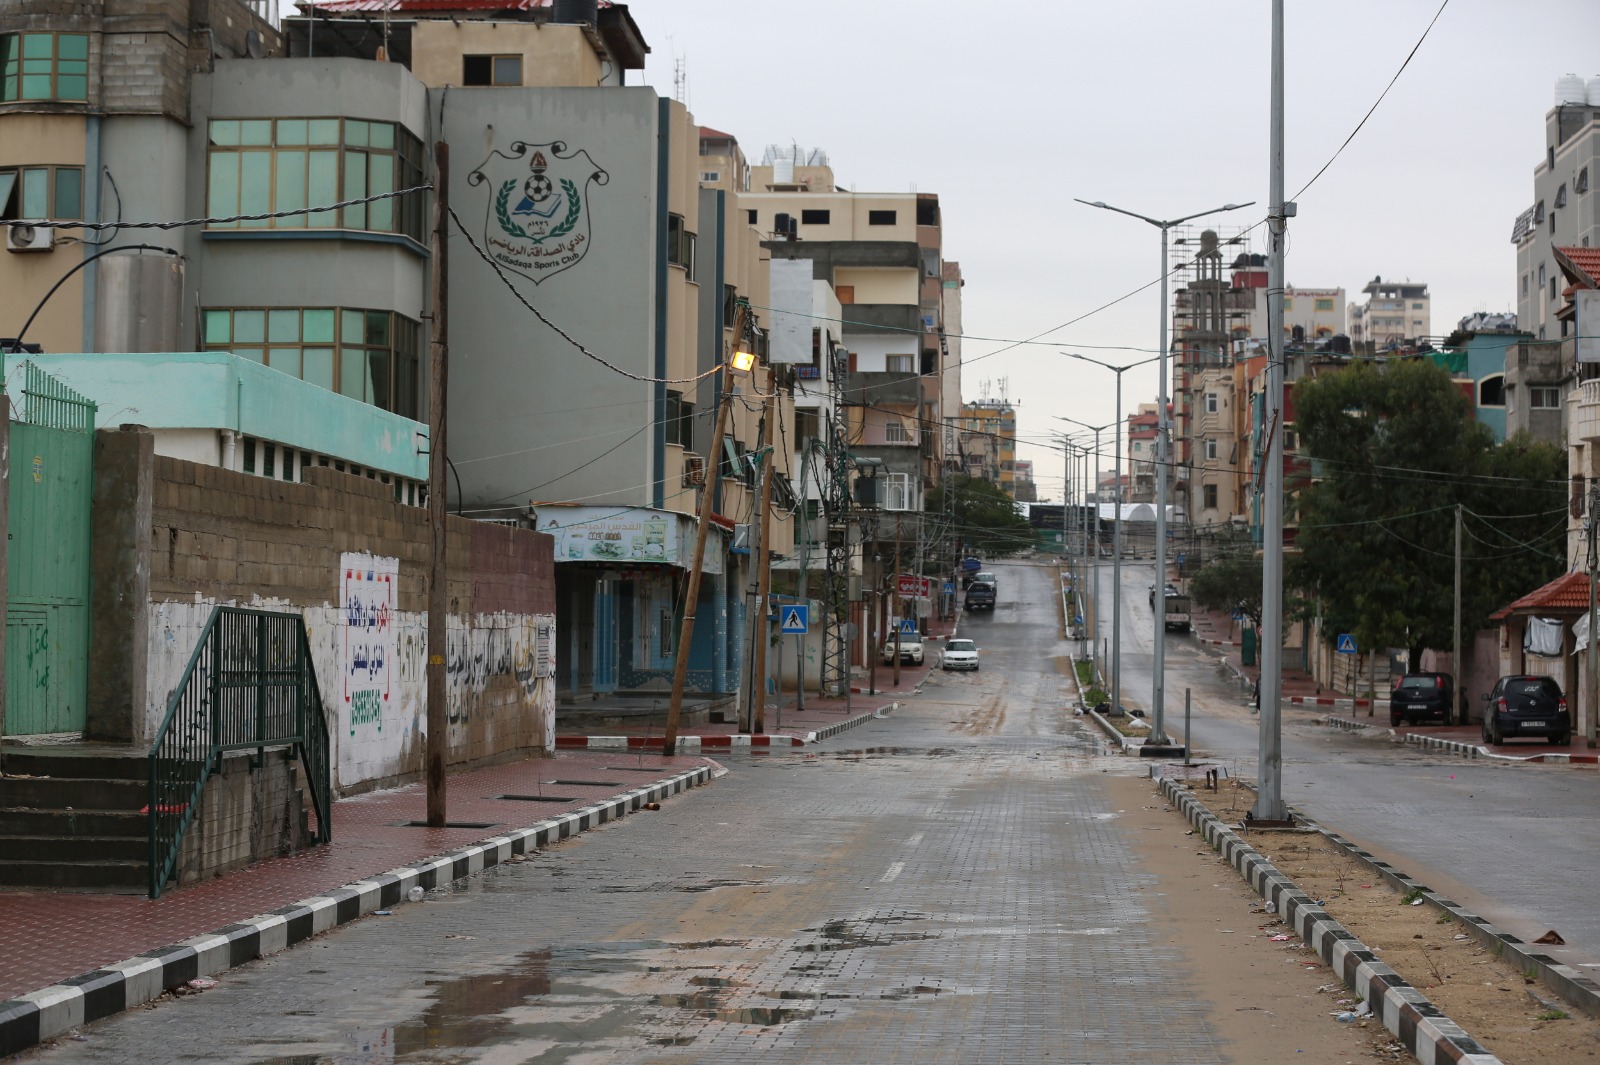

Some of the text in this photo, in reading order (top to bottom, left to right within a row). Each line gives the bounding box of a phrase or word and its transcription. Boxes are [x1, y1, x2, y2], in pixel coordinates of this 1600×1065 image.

[488, 233, 586, 257] نادي الصداقة الرياضي
[495, 252, 580, 270] AlSadaqa Sports Club
[607, 522, 641, 531] القدس
